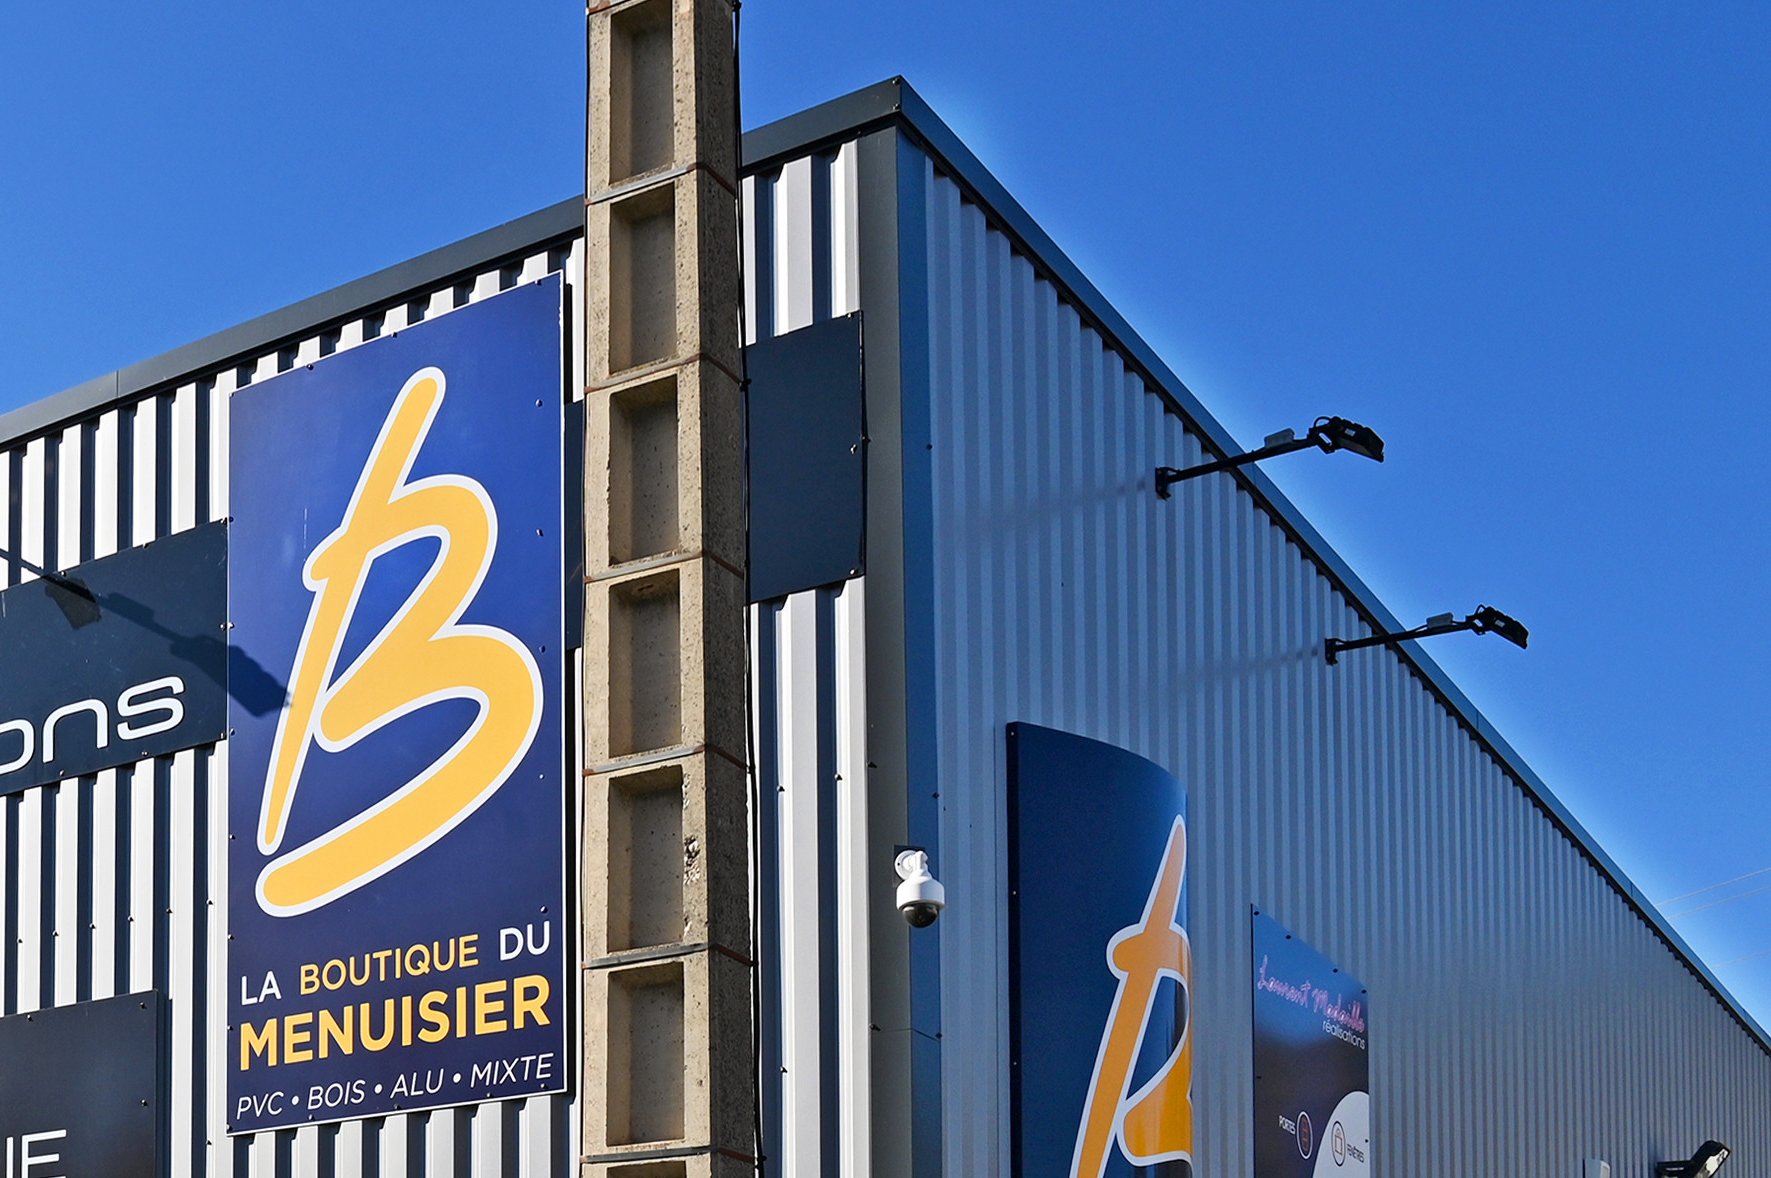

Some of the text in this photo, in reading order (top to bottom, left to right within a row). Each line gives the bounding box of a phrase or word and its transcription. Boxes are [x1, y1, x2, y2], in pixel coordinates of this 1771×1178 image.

[240, 920, 551, 1006] LA BOUTIQUE DU
[240, 974, 551, 1071] MENUISIER
[1322, 1019, 1366, 1050] réalisations
[236, 1052, 555, 1120] PVC BOIS ALU MIXTE
